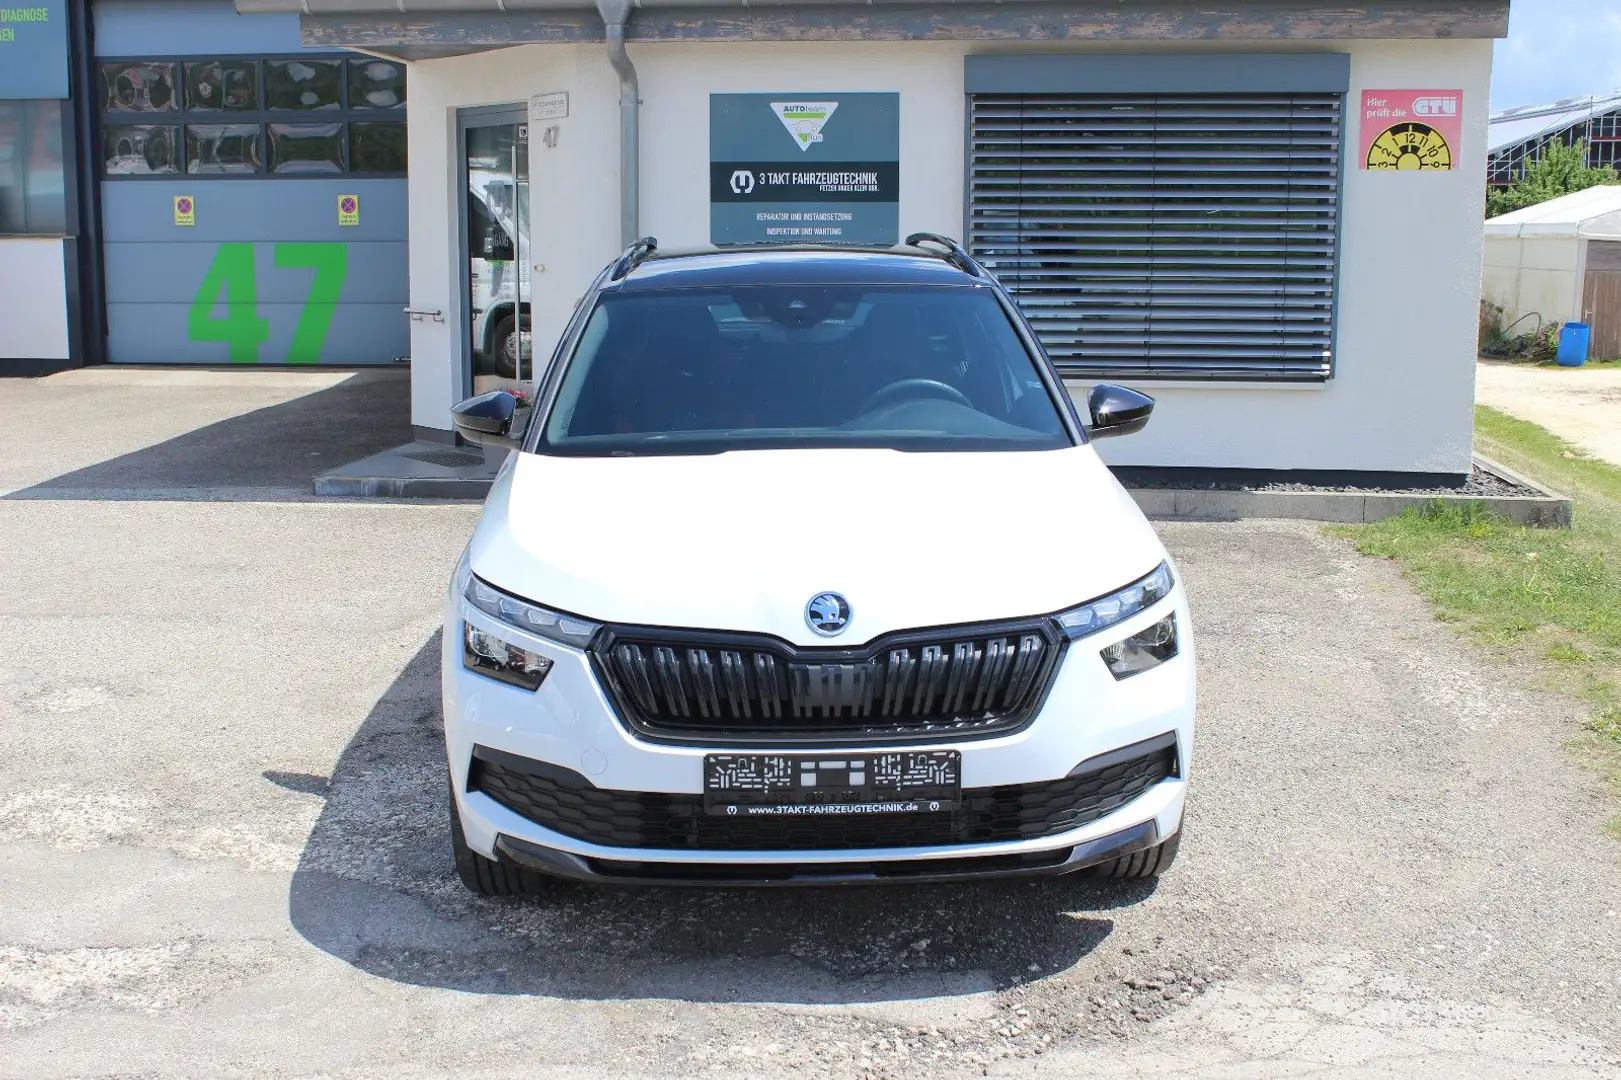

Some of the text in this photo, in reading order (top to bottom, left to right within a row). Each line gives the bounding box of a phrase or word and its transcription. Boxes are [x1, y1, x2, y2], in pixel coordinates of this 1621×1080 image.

[1367, 98, 1387, 107] Hier
[1413, 97, 1457, 115] GTÜ
[1366, 108, 1407, 119] prüft die
[543, 125, 560, 148] 47
[1404, 133, 1416, 143] 12
[759, 172, 878, 184] 3 TAKT FAHRZEUGTECHNIK
[756, 212, 853, 221] REPARATUR UND INSTANDSETZUNG
[766, 227, 842, 235] INSPEKTION UND WARTUNG
[188, 243, 348, 364] 47
[748, 802, 918, 814] www.3TAKT-FAHRZEUGTECHNIK.de
